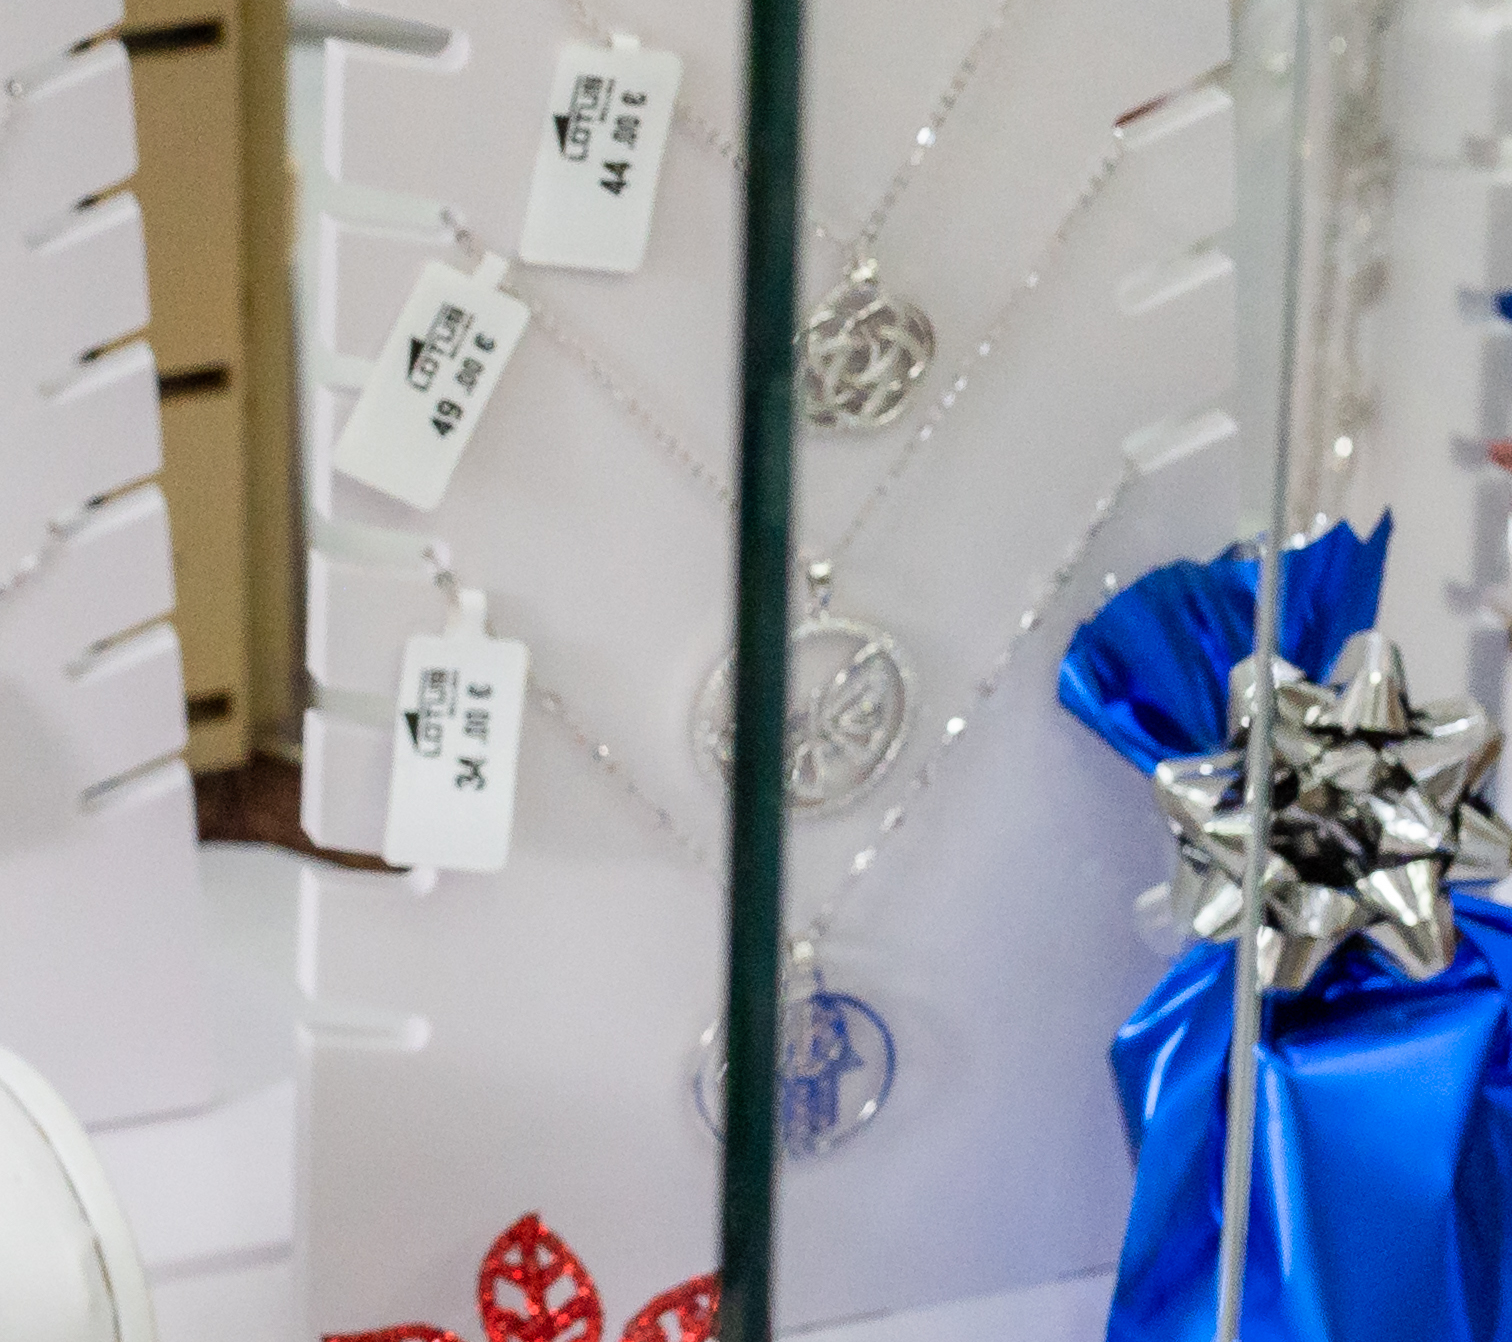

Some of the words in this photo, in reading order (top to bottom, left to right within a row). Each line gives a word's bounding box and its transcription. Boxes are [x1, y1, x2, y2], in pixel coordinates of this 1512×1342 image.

[599, 161, 632, 197] 44
[430, 398, 464, 438] 49
[453, 757, 486, 792] 34
